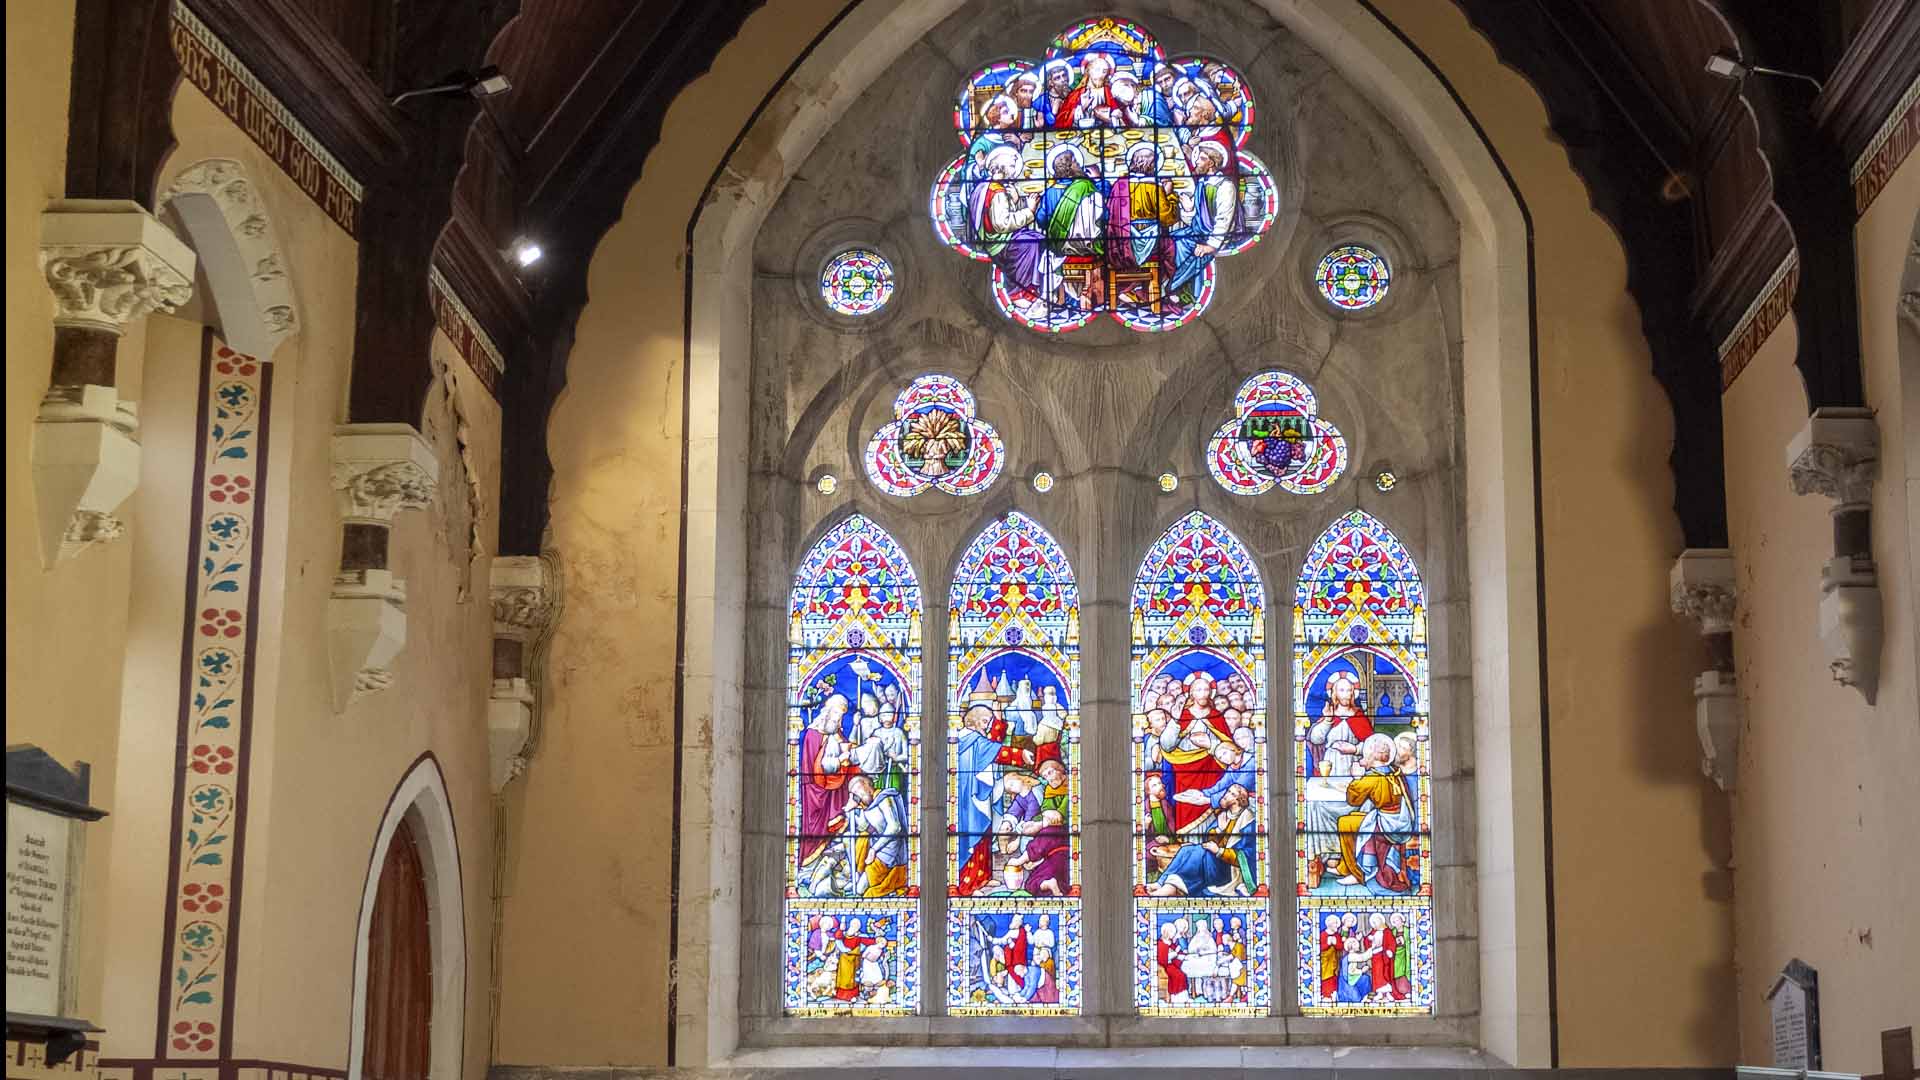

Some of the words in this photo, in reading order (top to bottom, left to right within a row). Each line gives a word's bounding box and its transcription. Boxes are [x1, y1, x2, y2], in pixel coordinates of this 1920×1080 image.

[245, 91, 286, 164] UNTO
[290, 139, 321, 196] GOD
[325, 179, 355, 234] FOR
